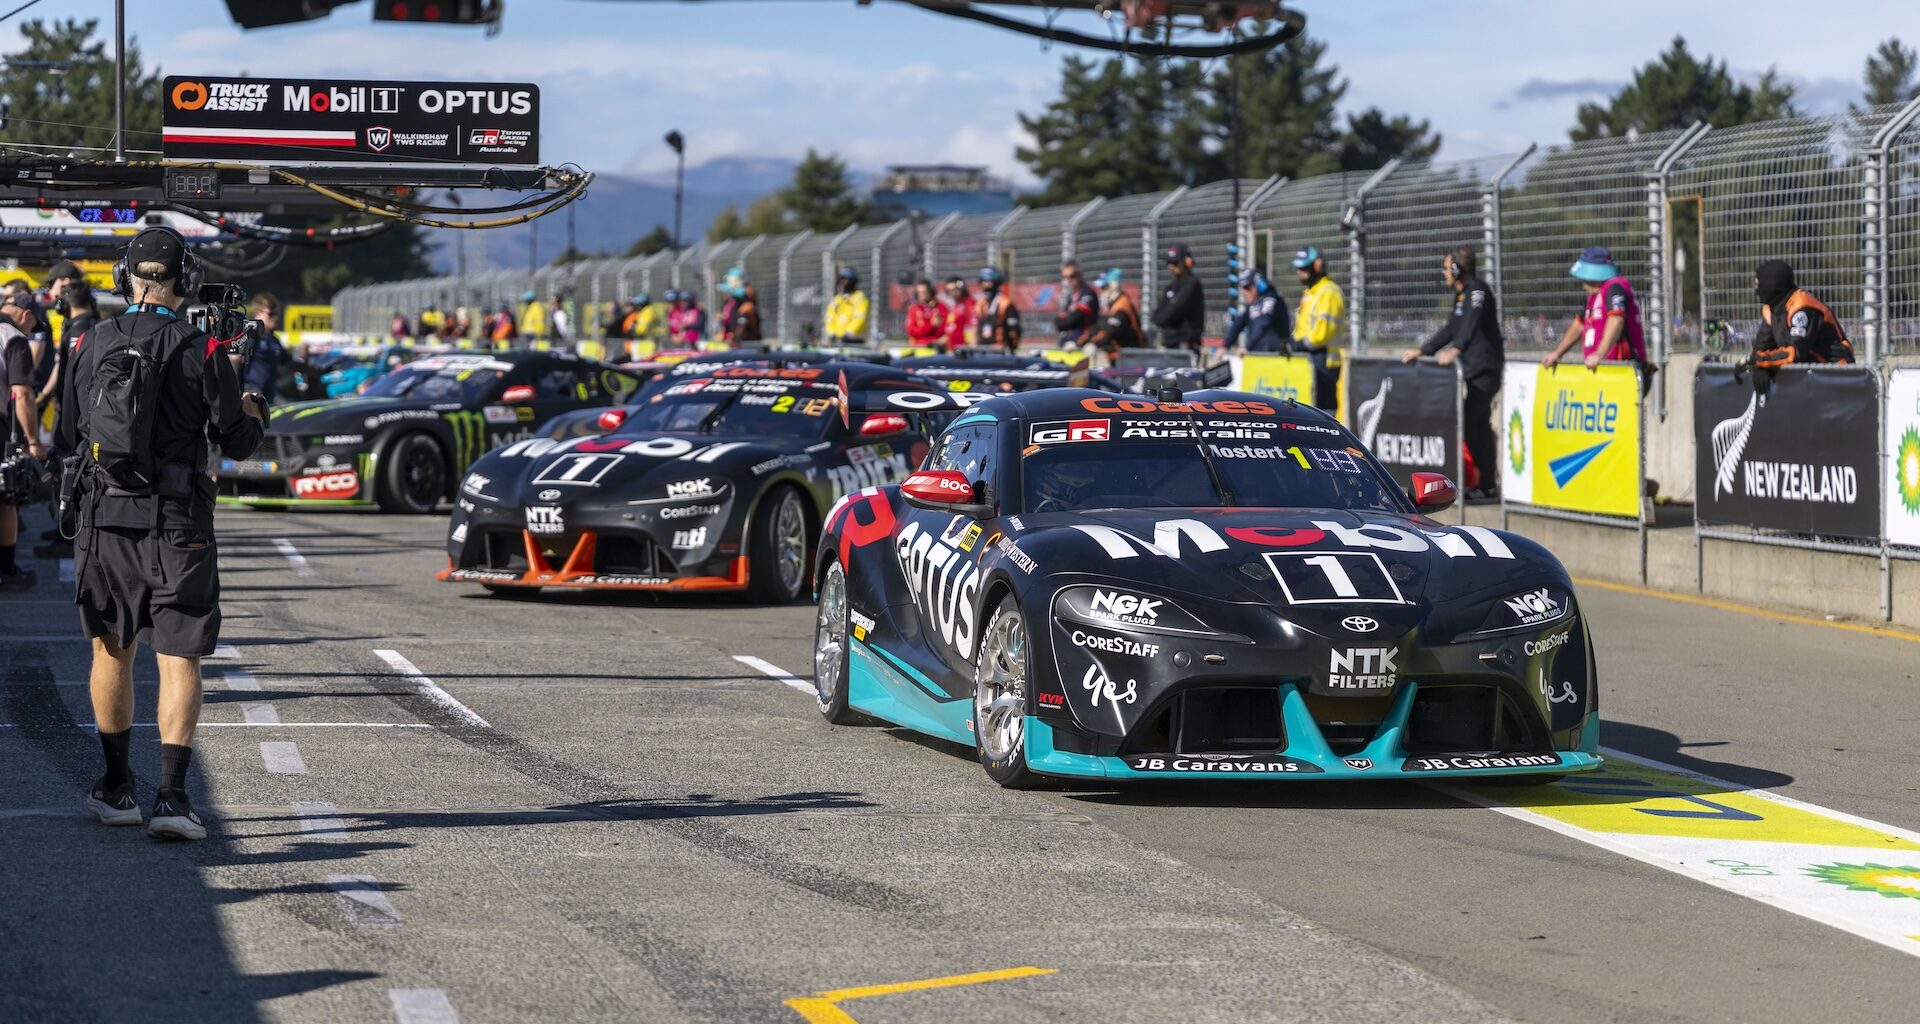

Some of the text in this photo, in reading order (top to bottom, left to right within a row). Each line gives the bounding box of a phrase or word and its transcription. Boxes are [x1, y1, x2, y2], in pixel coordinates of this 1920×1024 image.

[209, 83, 270, 98] TRUCK
[284, 85, 389, 112] Mobil 1
[204, 97, 268, 112] ASSIST
[418, 89, 532, 115] OPTUS
[392, 133, 449, 141] WALKINSHAW
[471, 134, 498, 145] GR
[80, 208, 137, 223] GROVE
[771, 396, 796, 414] 2
[1080, 397, 1277, 416] Coates
[1546, 389, 1618, 433] ultimate
[1033, 427, 1107, 443] GR
[1121, 427, 1271, 440] Australia
[1209, 420, 1278, 429] GAZOO
[1281, 423, 1340, 436] Racing
[1286, 446, 1313, 470] 1
[1376, 432, 1445, 467] NEW ZEALAND
[560, 456, 599, 480] 1
[296, 473, 357, 495] RYCO
[666, 477, 712, 495] NGK
[939, 478, 971, 494] BOC
[1744, 460, 1858, 504] NEW ZEALAND
[525, 506, 565, 523] NTK
[528, 522, 565, 534] FILTERS
[1069, 518, 1516, 560] Mobil
[575, 575, 671, 584] JB Caravans
[1303, 555, 1360, 597] 1
[897, 521, 980, 660] OPTUS
[1090, 588, 1163, 619] NGK
[1504, 587, 1558, 618] NGK
[1089, 610, 1156, 626] SPARK PLUGS
[1521, 607, 1562, 623] SPARK PLUGS
[974, 605, 1001, 685] DUNLOP
[1330, 646, 1399, 674] NTK
[1328, 673, 1397, 689] FILTERS
[1134, 758, 1298, 772] JB Caravans
[1418, 753, 1557, 770] JB Caravans
